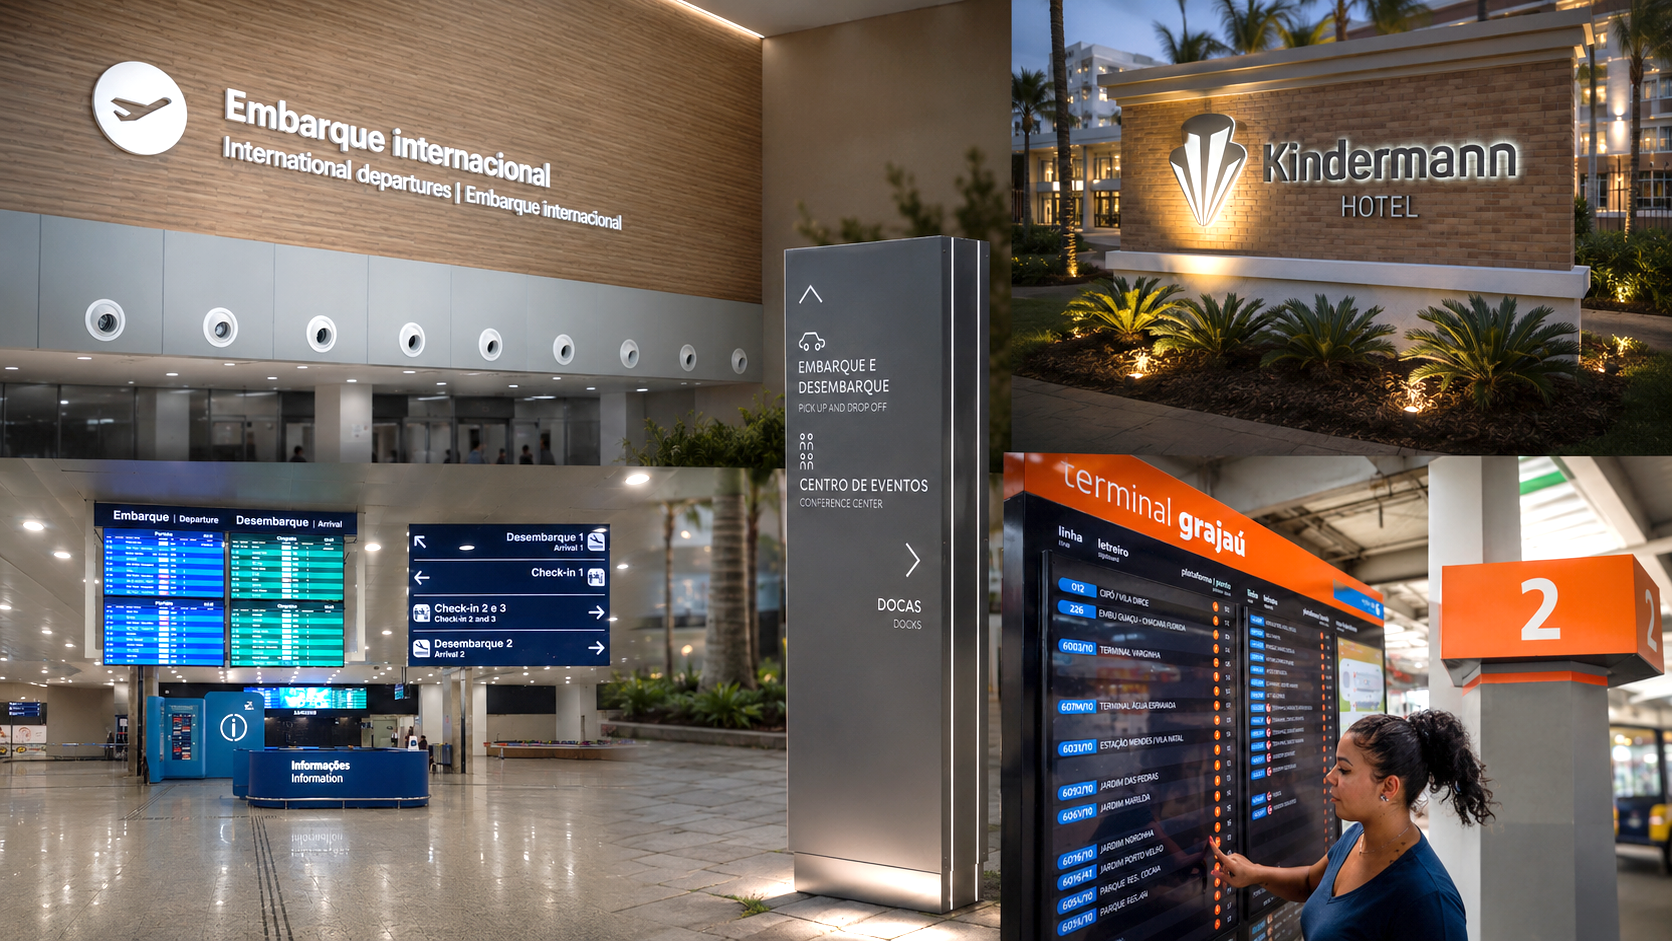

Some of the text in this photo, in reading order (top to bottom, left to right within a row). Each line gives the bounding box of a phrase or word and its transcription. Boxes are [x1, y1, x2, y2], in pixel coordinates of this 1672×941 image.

[224, 86, 551, 188] Embarque internacional
[1262, 139, 1517, 183] Kindermann
[222, 135, 352, 181] International
[355, 163, 452, 200] departures
[464, 184, 540, 216] Embarque
[541, 200, 623, 231] internacional
[1341, 194, 1419, 219] HOTEL
[798, 358, 877, 375] EMBARQUE E
[798, 379, 890, 395] DESEMBARQUE
[798, 401, 888, 413] PICK UP AND DROP OFF
[800, 478, 929, 493] CENTRO DE EVENTOS
[799, 497, 883, 509] CONFERENCE CENTER
[1060, 457, 1246, 558] terminal grajaú
[113, 509, 170, 524] Embarque
[179, 514, 219, 525] Departure
[236, 515, 310, 529] Desembarque
[317, 520, 343, 529] Arrival
[506, 532, 584, 544] Desembarque 1
[1058, 525, 1083, 543] linha
[553, 544, 584, 552] Arrival 1
[1097, 538, 1129, 557] letreiro
[531, 567, 584, 578] Check-in 1
[1071, 582, 1085, 594] 012
[434, 603, 507, 614] Check-in 2 e 3
[877, 597, 922, 613] DOCAS
[1069, 604, 1084, 615] 226
[1520, 577, 1561, 641] 2
[468, 615, 474, 623] 2
[474, 615, 490, 623] and
[490, 615, 496, 623] 3
[893, 618, 922, 630] DOCKS
[1645, 588, 1658, 653] 2
[434, 639, 513, 651] Desembarque 2
[434, 650, 465, 658] Arrival 2
[291, 760, 351, 775] Informações
[291, 773, 343, 783] Information
